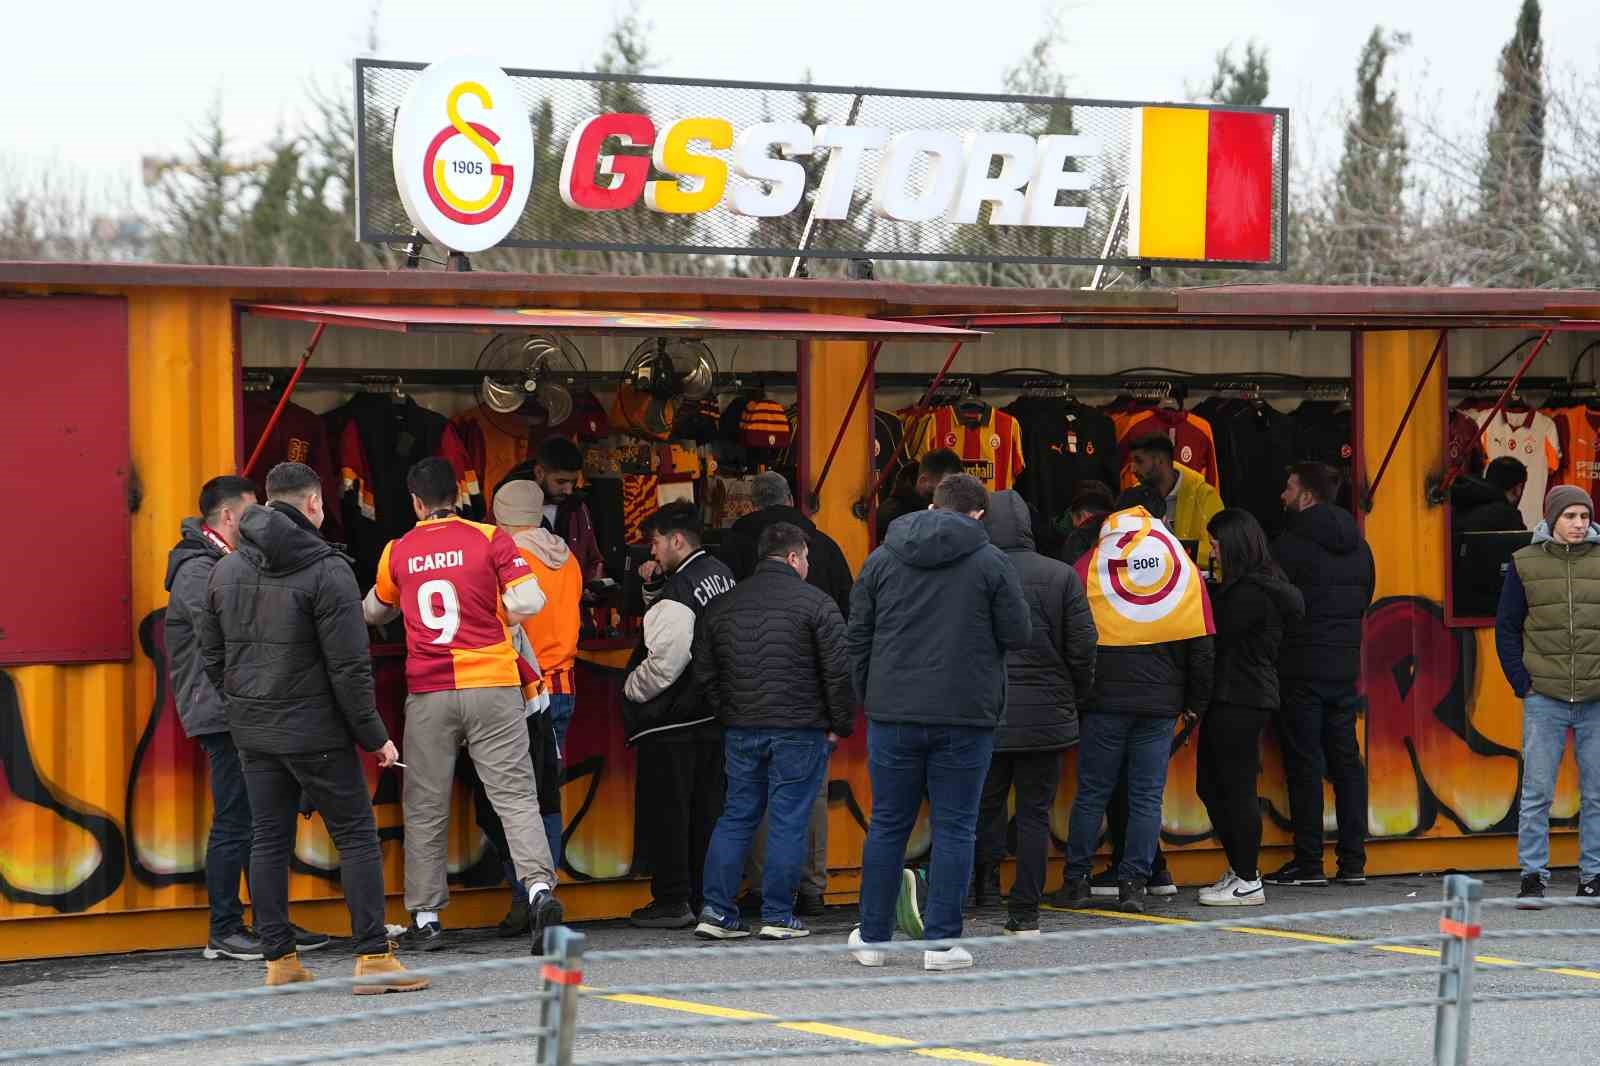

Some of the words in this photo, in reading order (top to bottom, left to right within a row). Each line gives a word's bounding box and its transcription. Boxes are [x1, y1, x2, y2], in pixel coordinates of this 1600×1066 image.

[452, 160, 483, 175] 1905
[408, 550, 463, 574] ICARDI
[417, 579, 460, 645] 9
